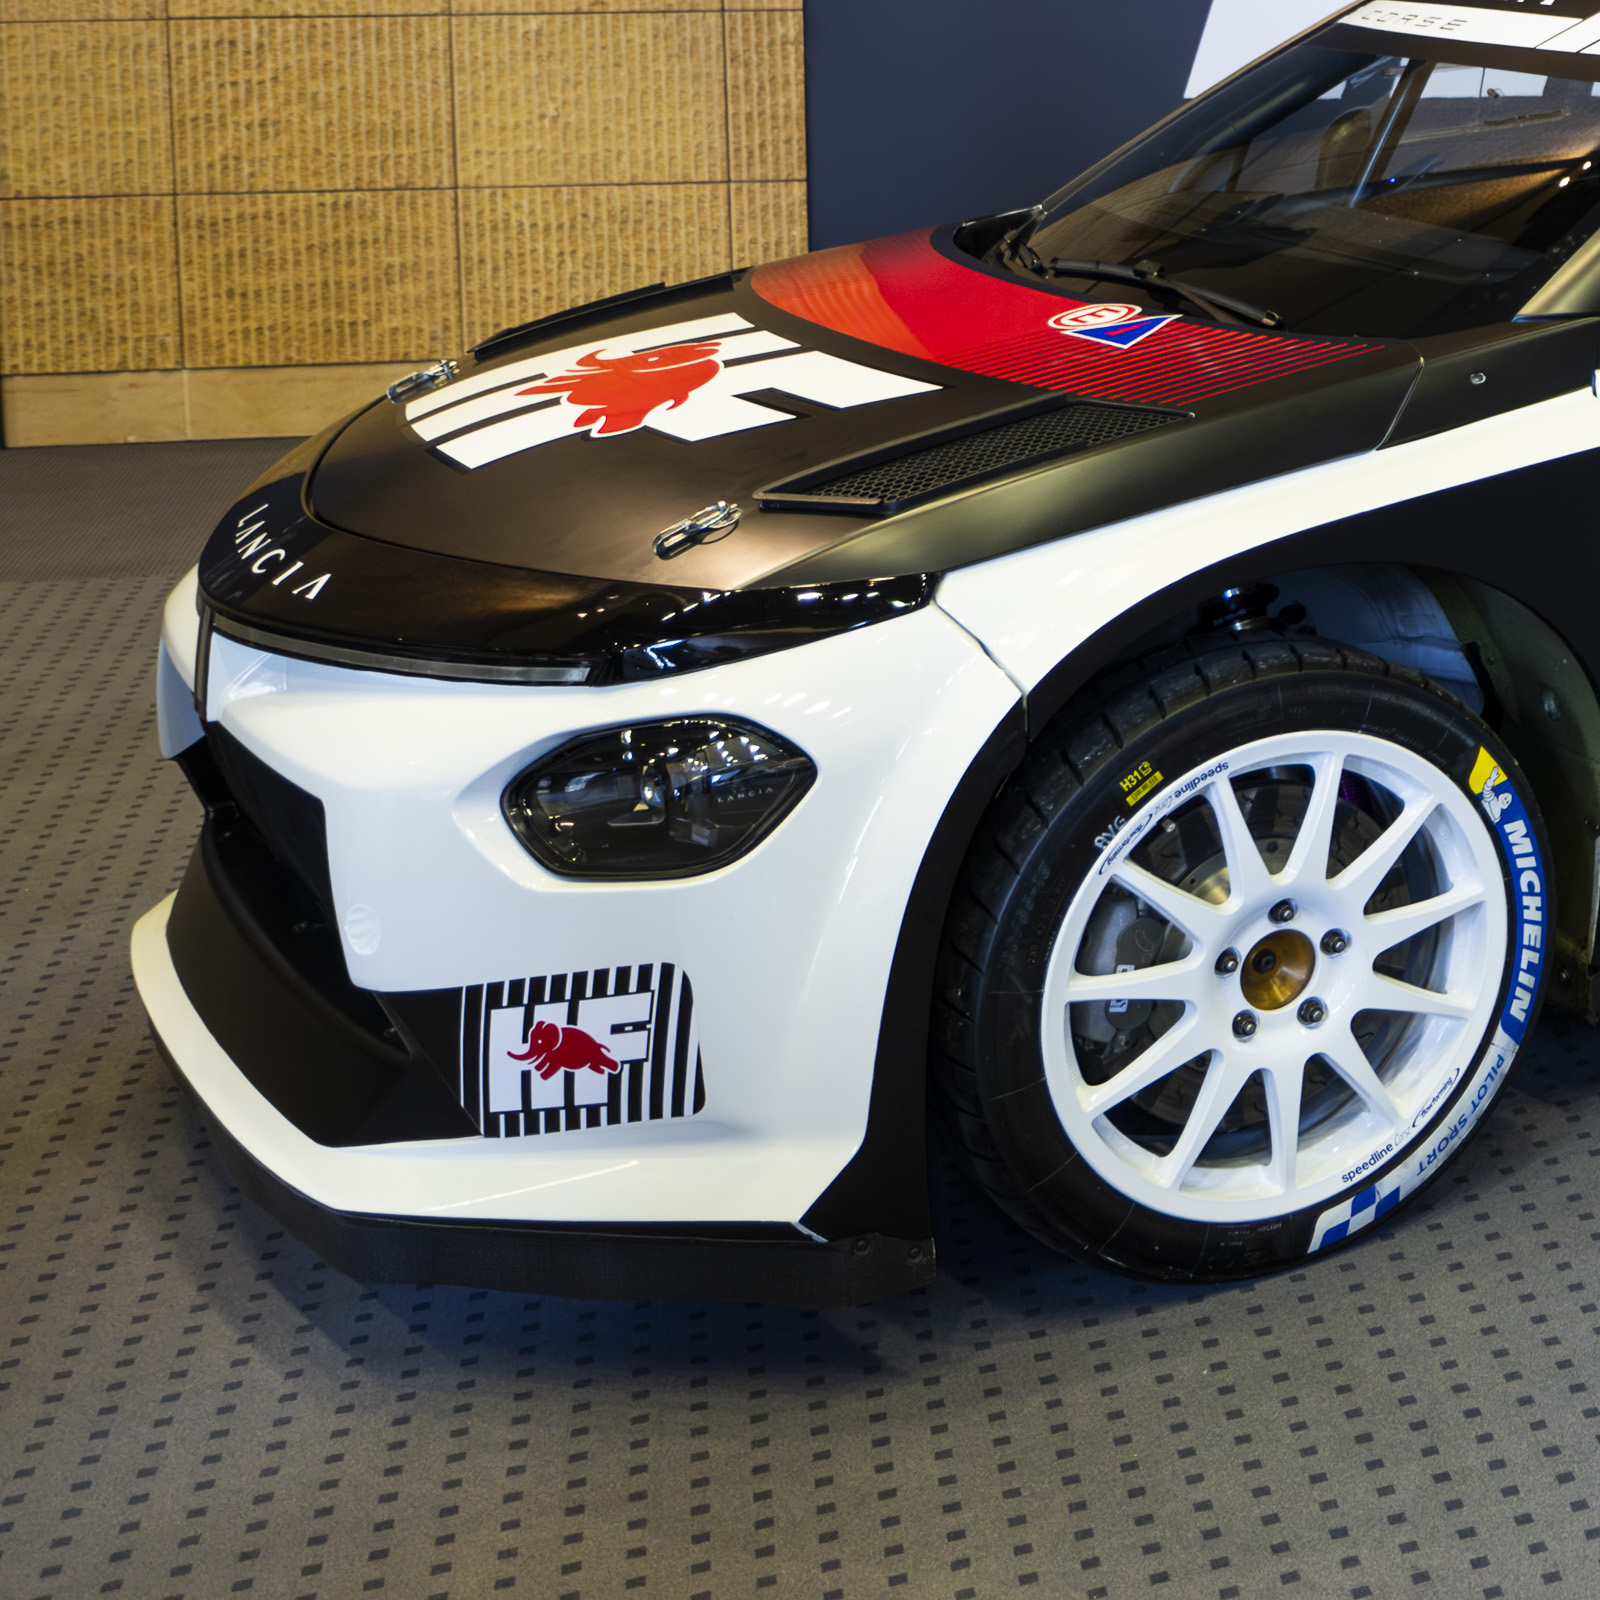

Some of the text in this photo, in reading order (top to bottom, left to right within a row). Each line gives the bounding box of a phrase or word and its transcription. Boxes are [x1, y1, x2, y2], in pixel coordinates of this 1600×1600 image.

[1361, 9, 1468, 32] CORSE
[235, 503, 332, 600] LANCIA
[1174, 761, 1230, 798] speedline
[1503, 819, 1542, 1023] MICHELIN
[1416, 1053, 1505, 1177] PILOT SPORT
[1341, 1143, 1394, 1183] speedline
